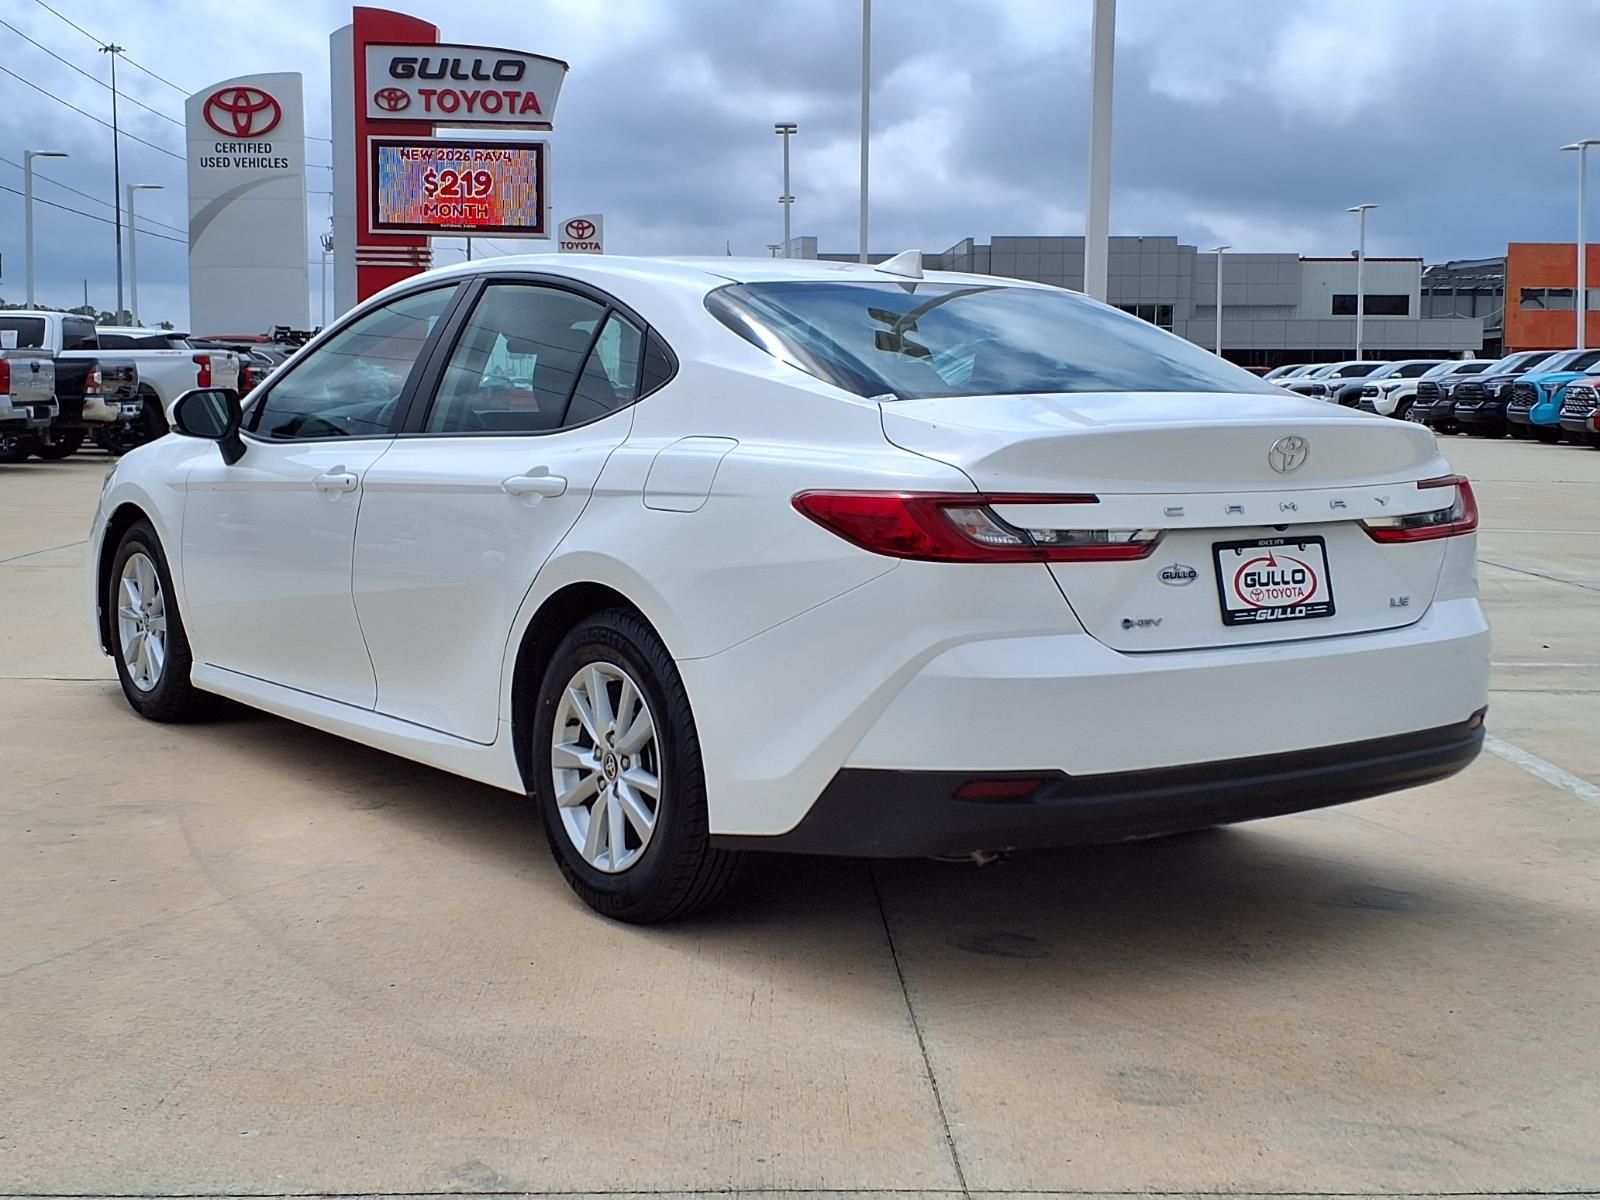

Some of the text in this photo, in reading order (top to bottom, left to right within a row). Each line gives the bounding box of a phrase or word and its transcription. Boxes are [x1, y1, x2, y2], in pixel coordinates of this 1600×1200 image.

[389, 57, 526, 81] GULLO
[418, 88, 542, 114] TOYOTA
[215, 142, 272, 154] CERTIFIED
[400, 149, 512, 162] NEW 2026 RAV4
[200, 157, 289, 169] USED VEHICLES
[423, 167, 493, 198] $219
[423, 203, 489, 218] MONTH
[560, 241, 601, 250] TOYOTA
[1164, 496, 1391, 517] CAMRY
[1162, 570, 1197, 579] GULLO
[1244, 568, 1306, 588] GULLO
[1265, 586, 1305, 599] TOYOTA
[1390, 597, 1409, 608] LE
[1255, 606, 1307, 621] GULLO
